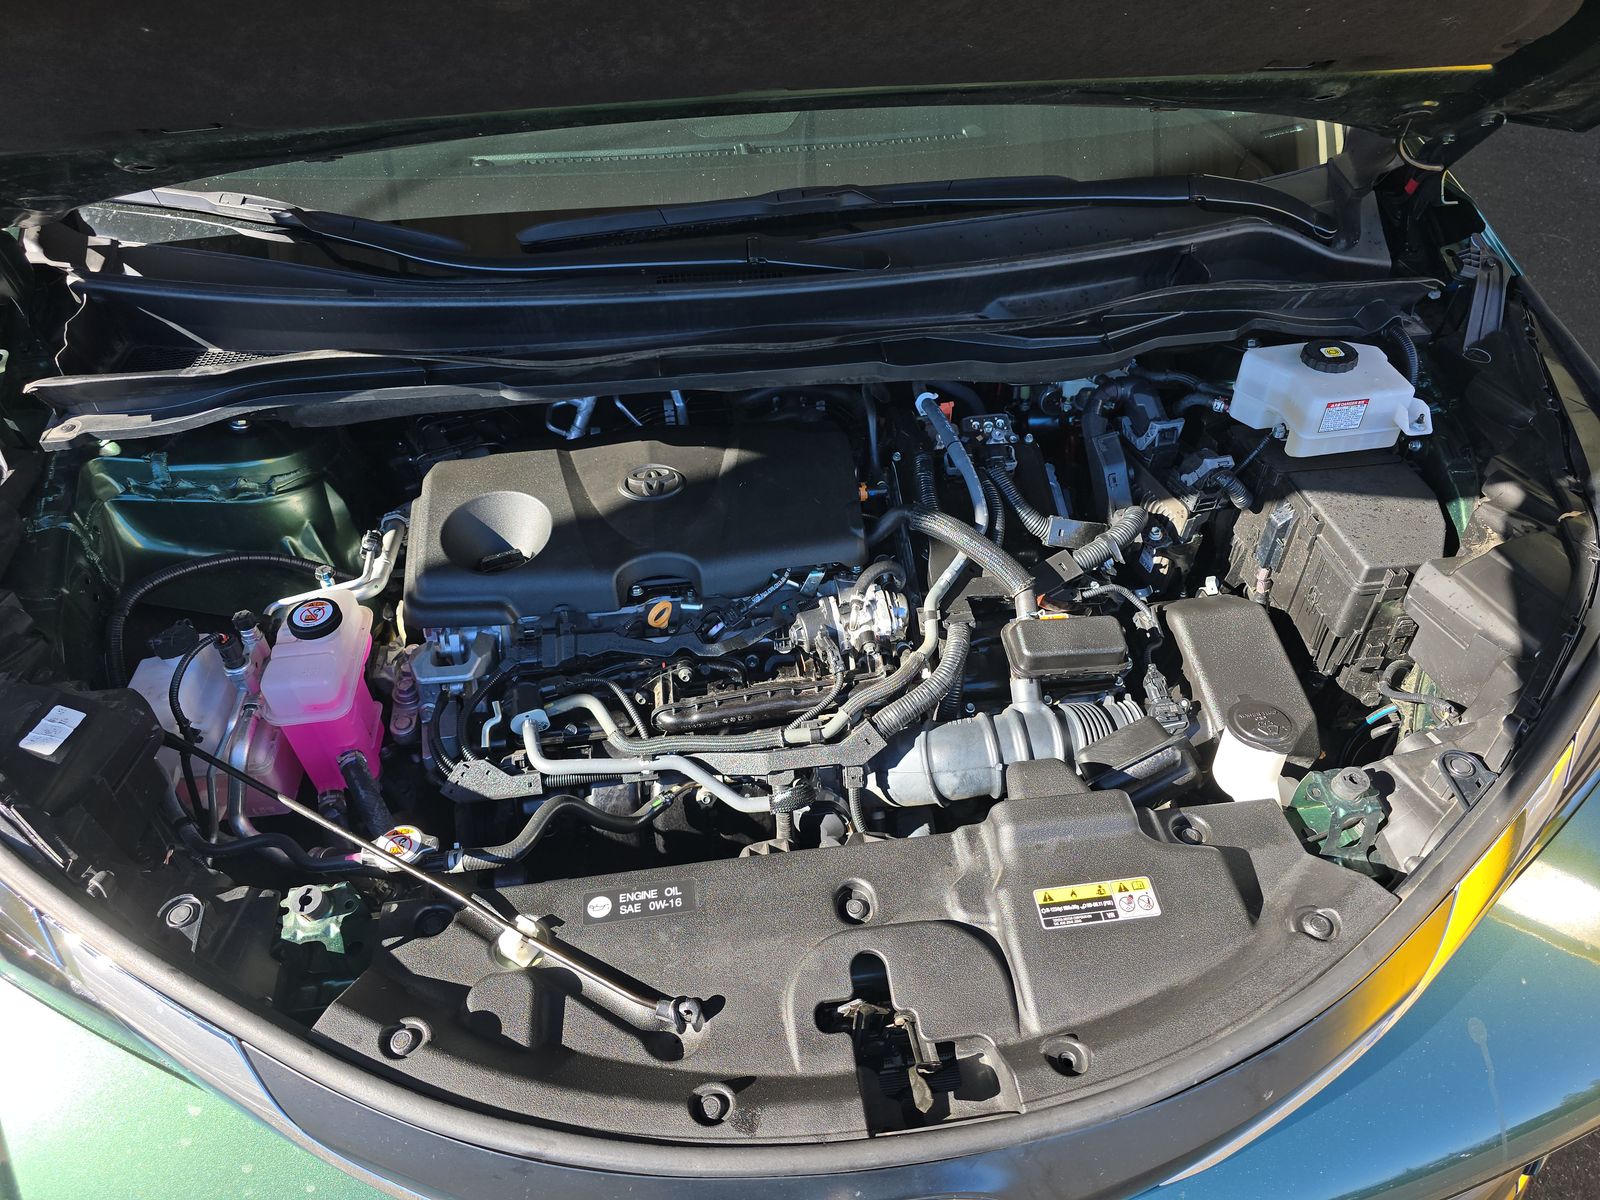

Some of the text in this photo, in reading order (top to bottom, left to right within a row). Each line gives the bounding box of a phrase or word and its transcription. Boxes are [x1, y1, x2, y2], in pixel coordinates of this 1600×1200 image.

[619, 886, 682, 903] ENGINE OIL
[619, 898, 682, 915] SAE 0W-16
